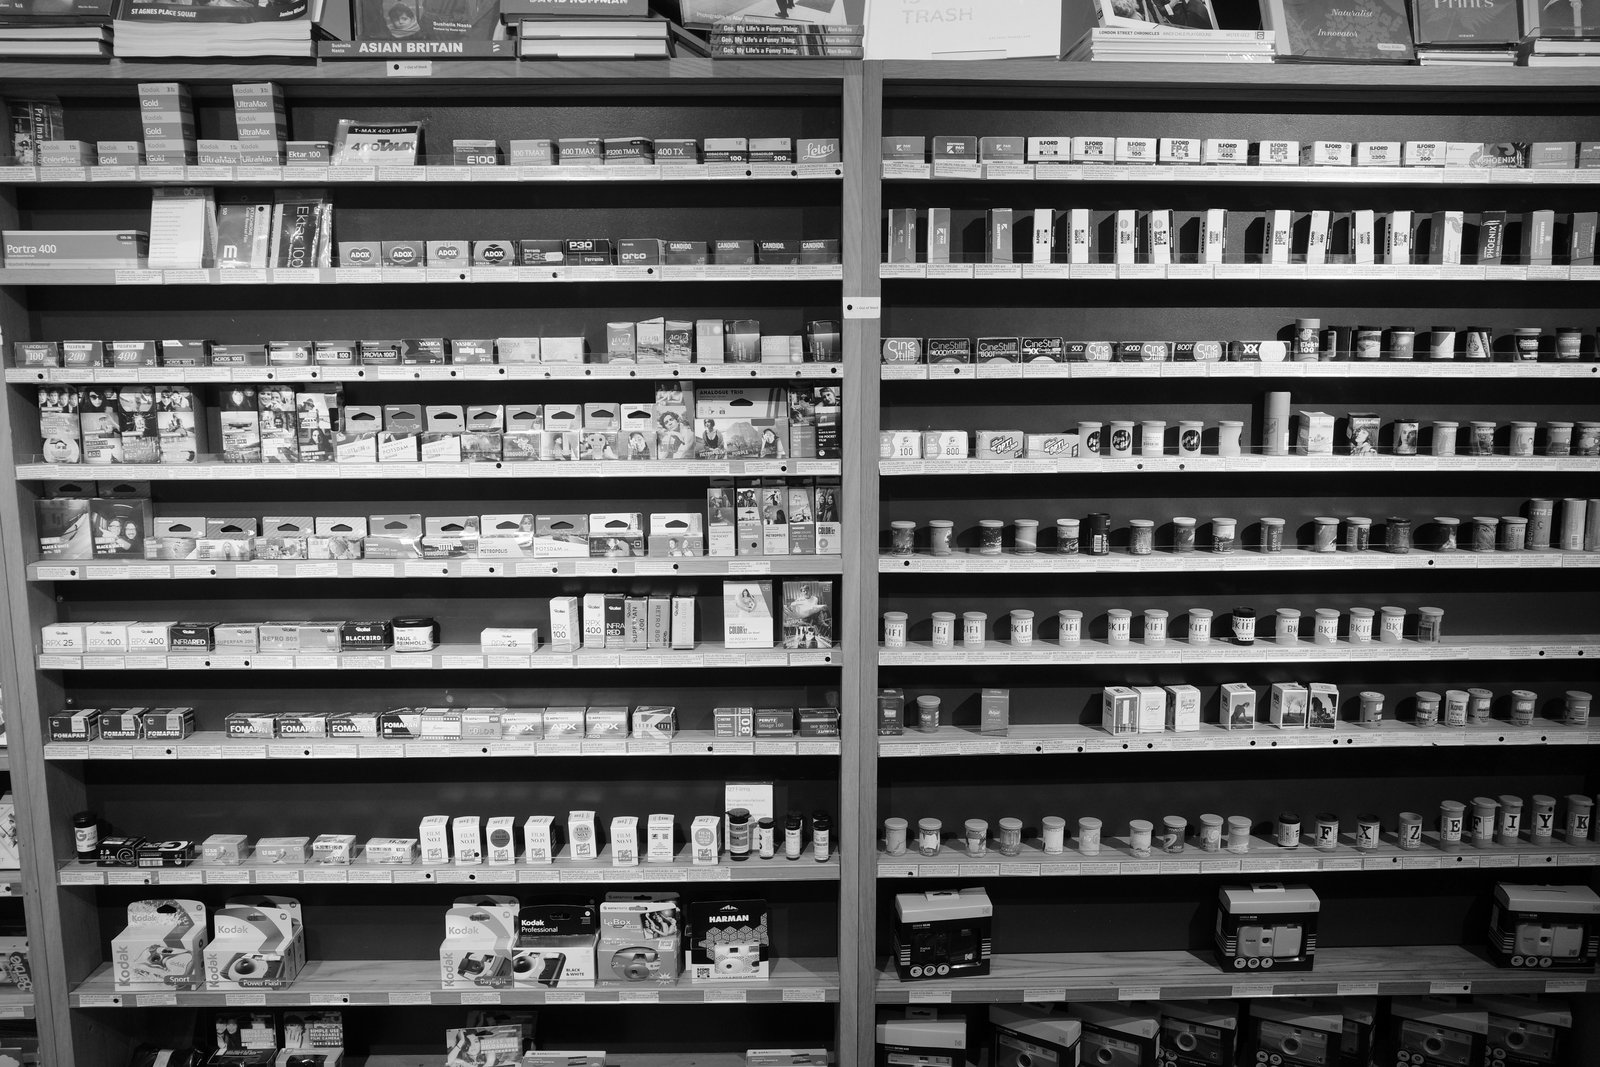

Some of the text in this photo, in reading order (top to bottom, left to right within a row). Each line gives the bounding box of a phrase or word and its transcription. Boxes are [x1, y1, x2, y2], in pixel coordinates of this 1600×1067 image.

[902, 8, 973, 25] TRASH
[1331, 8, 1373, 18] Naturalist
[737, 25, 744, 33] My
[766, 25, 781, 33] Funny
[783, 25, 798, 33] Thing
[1317, 28, 1358, 38] Innovator
[359, 42, 464, 53] ASIAN BRITAIN
[737, 47, 744, 55] My
[765, 47, 781, 55] Funny
[782, 47, 797, 55] Thing
[236, 100, 267, 108] UltraMax
[239, 128, 270, 136] UltraMax
[657, 148, 672, 156] 400
[803, 142, 835, 160] Leica
[42, 156, 76, 164] ColorPlus
[467, 155, 495, 164] E100
[291, 206, 309, 268] Ektar 100
[569, 241, 593, 249] P30
[1486, 225, 1497, 259] PHOENIX
[7, 244, 57, 254] Portra 400
[484, 250, 503, 258] ADOX
[888, 340, 915, 350] Cine
[931, 341, 967, 350] CineStill
[980, 342, 1016, 351] CineStill
[1024, 340, 1061, 348] CineStill
[1088, 344, 1109, 353] Cine
[1197, 343, 1217, 353] Cine
[30, 352, 43, 360] 100
[68, 352, 86, 361] 200
[117, 351, 137, 360] 400
[900, 448, 913, 456] 100
[946, 448, 959, 456] 800
[585, 626, 601, 634] 400
[148, 637, 164, 645] 400
[173, 638, 206, 646] INFRARED
[345, 634, 381, 642] BLACKBIRD
[230, 725, 268, 733] FOMAPAN
[281, 725, 321, 733] FOMAPAN
[1450, 819, 1461, 832] E
[1539, 815, 1552, 828] Y
[1320, 827, 1332, 840] F
[1359, 827, 1371, 840] X
[1410, 827, 1420, 840] Z
[131, 914, 156, 922] Kodak
[709, 914, 750, 924] HARMAN
[521, 919, 545, 927] Kodak
[218, 925, 248, 934] Kodak
[449, 926, 479, 935] Kodak
[521, 926, 558, 934] Professional
[116, 945, 131, 987] Kodak
[207, 953, 220, 988] Kodak
[444, 952, 455, 987] Kodak
[169, 975, 191, 985] Sport
[243, 978, 282, 987] Power Flash
[480, 977, 507, 986] Daylight
